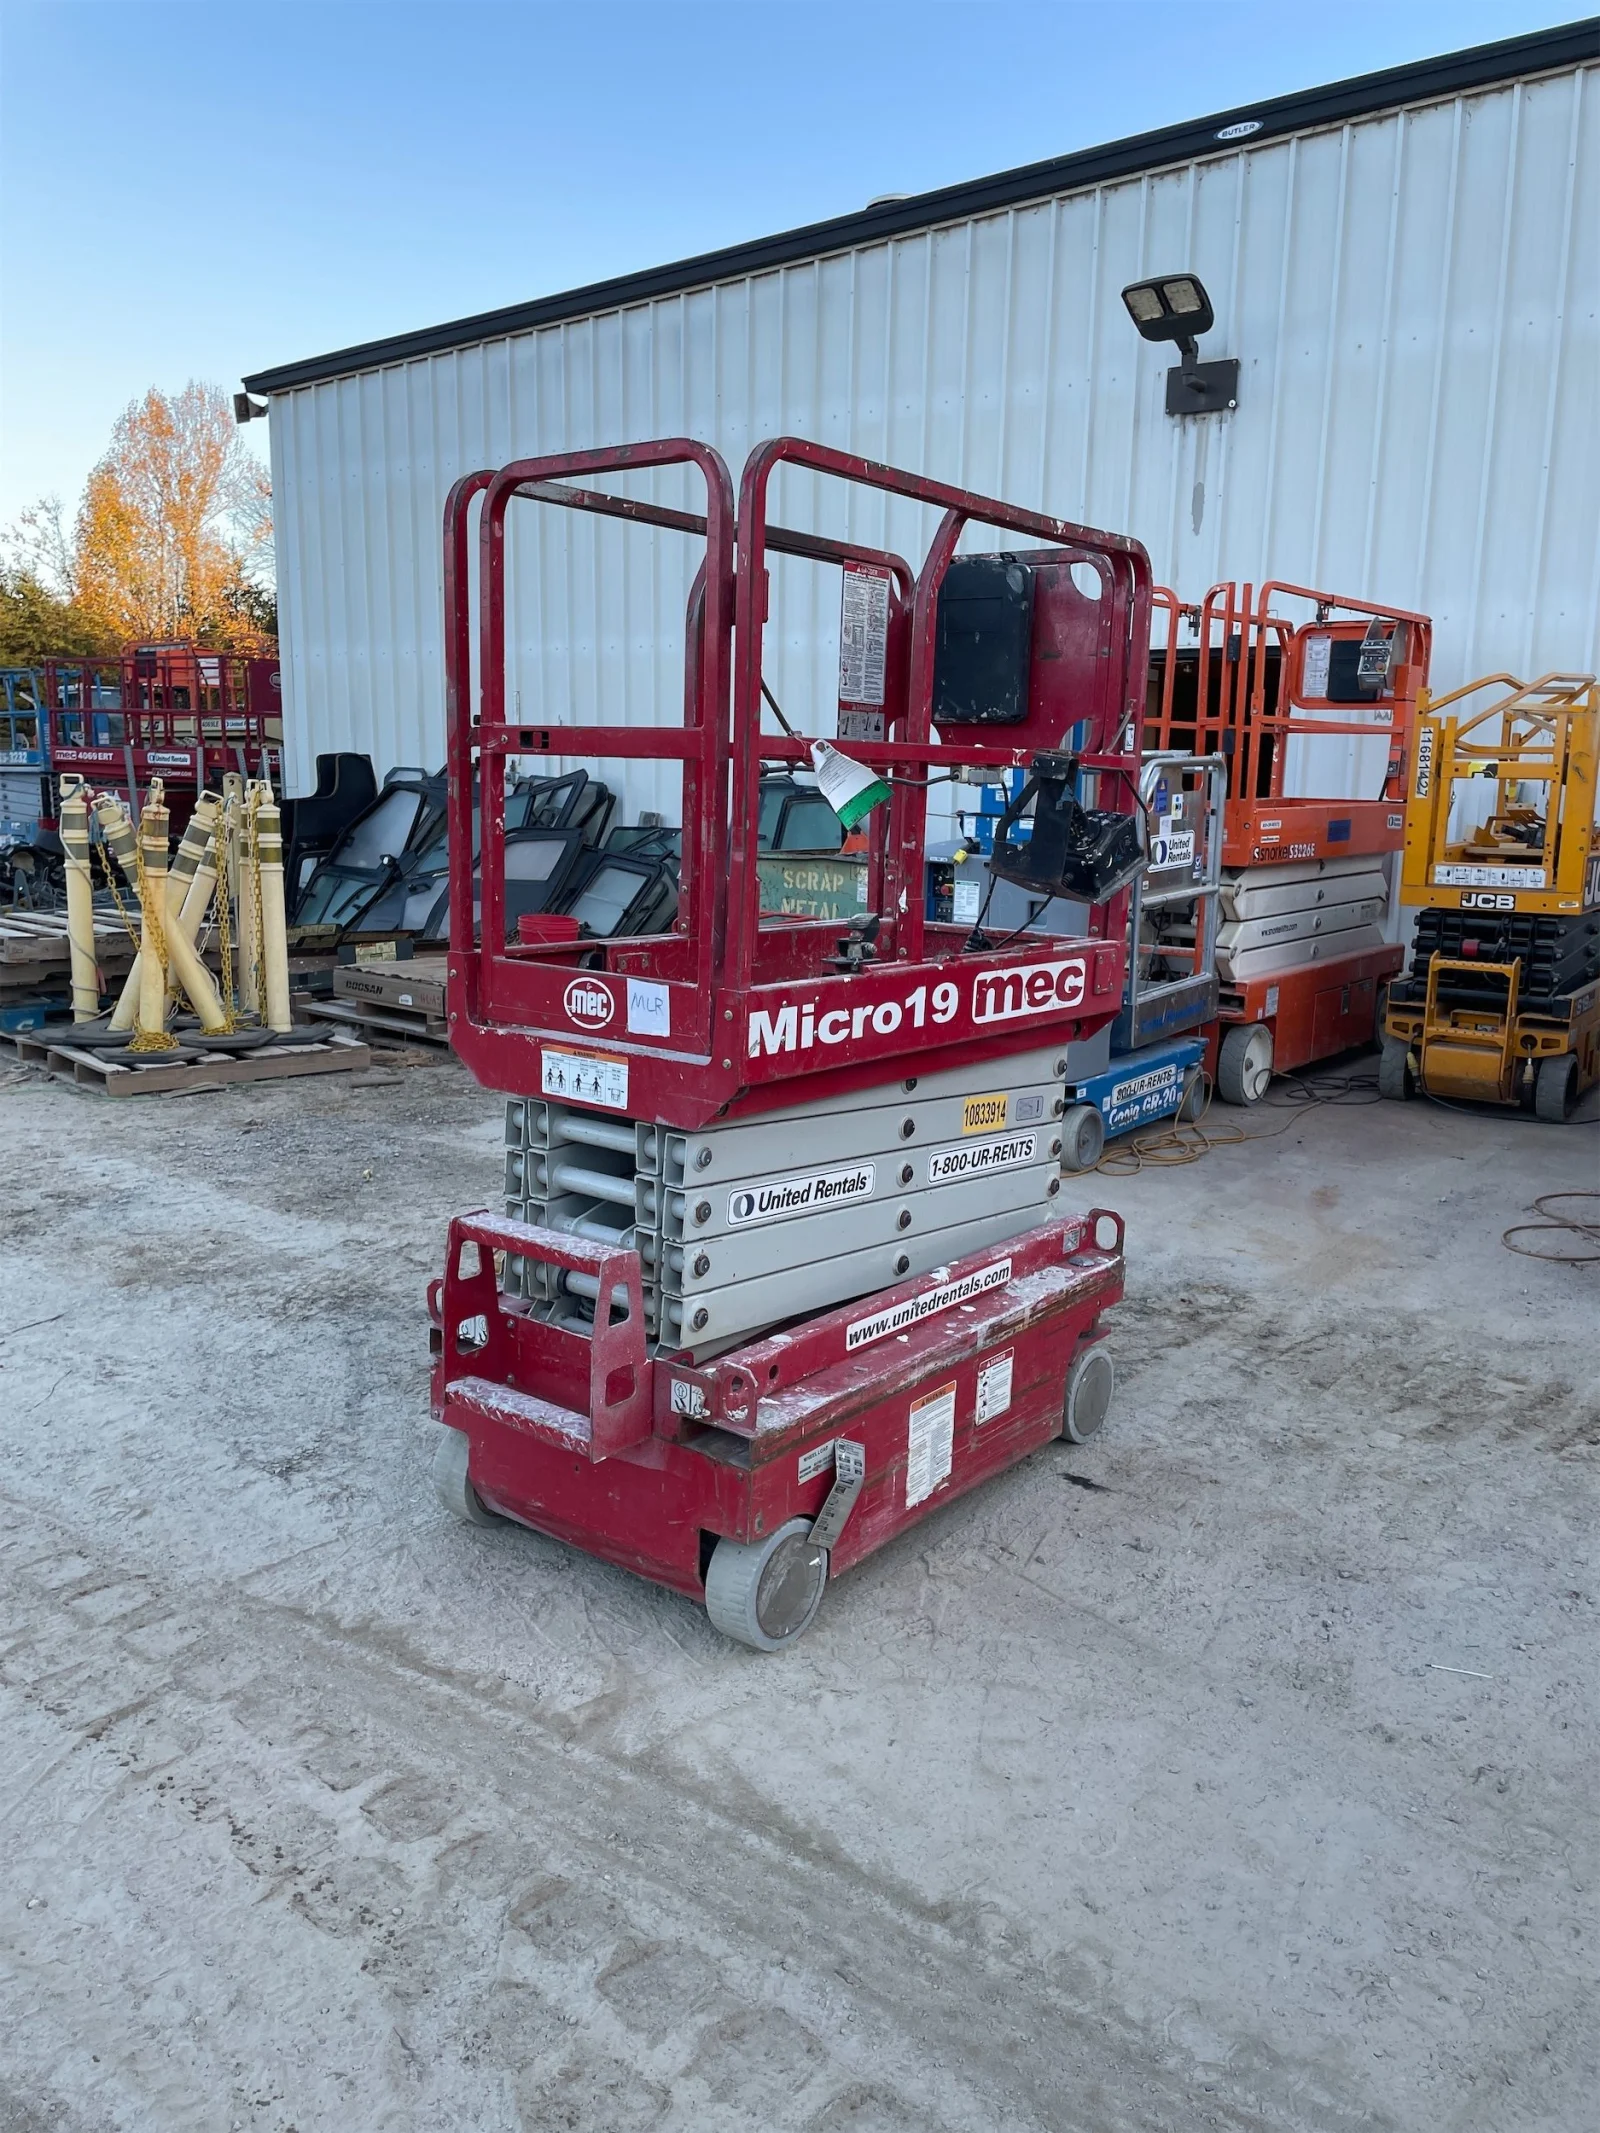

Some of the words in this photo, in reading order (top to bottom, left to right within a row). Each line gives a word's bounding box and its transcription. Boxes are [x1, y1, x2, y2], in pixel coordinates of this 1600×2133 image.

[1221, 123, 1256, 138] BUTLER
[56, 750, 77, 760] mec
[78, 752, 98, 761] 4069
[98, 752, 114, 761] ERT
[1416, 728, 1433, 797] 11681427
[1168, 838, 1190, 851] United
[1260, 843, 1289, 862] snorkel
[1288, 842, 1316, 860] S3226E
[1168, 850, 1192, 864] Rentals
[783, 870, 844, 893] SCRAP
[1461, 893, 1515, 909] JCB
[345, 980, 383, 996] DOOSAN
[571, 989, 608, 1018] mec
[631, 992, 665, 1016] MLR
[748, 981, 959, 1059] Micro19
[976, 964, 1085, 1019] mec
[963, 1100, 1007, 1127] 10833914
[931, 1138, 1034, 1178] 1-800-UR-RENTS
[757, 1184, 810, 1213] United
[813, 1172, 868, 1200] Rentals
[848, 1265, 1010, 1346] www.unitedrentals.com
